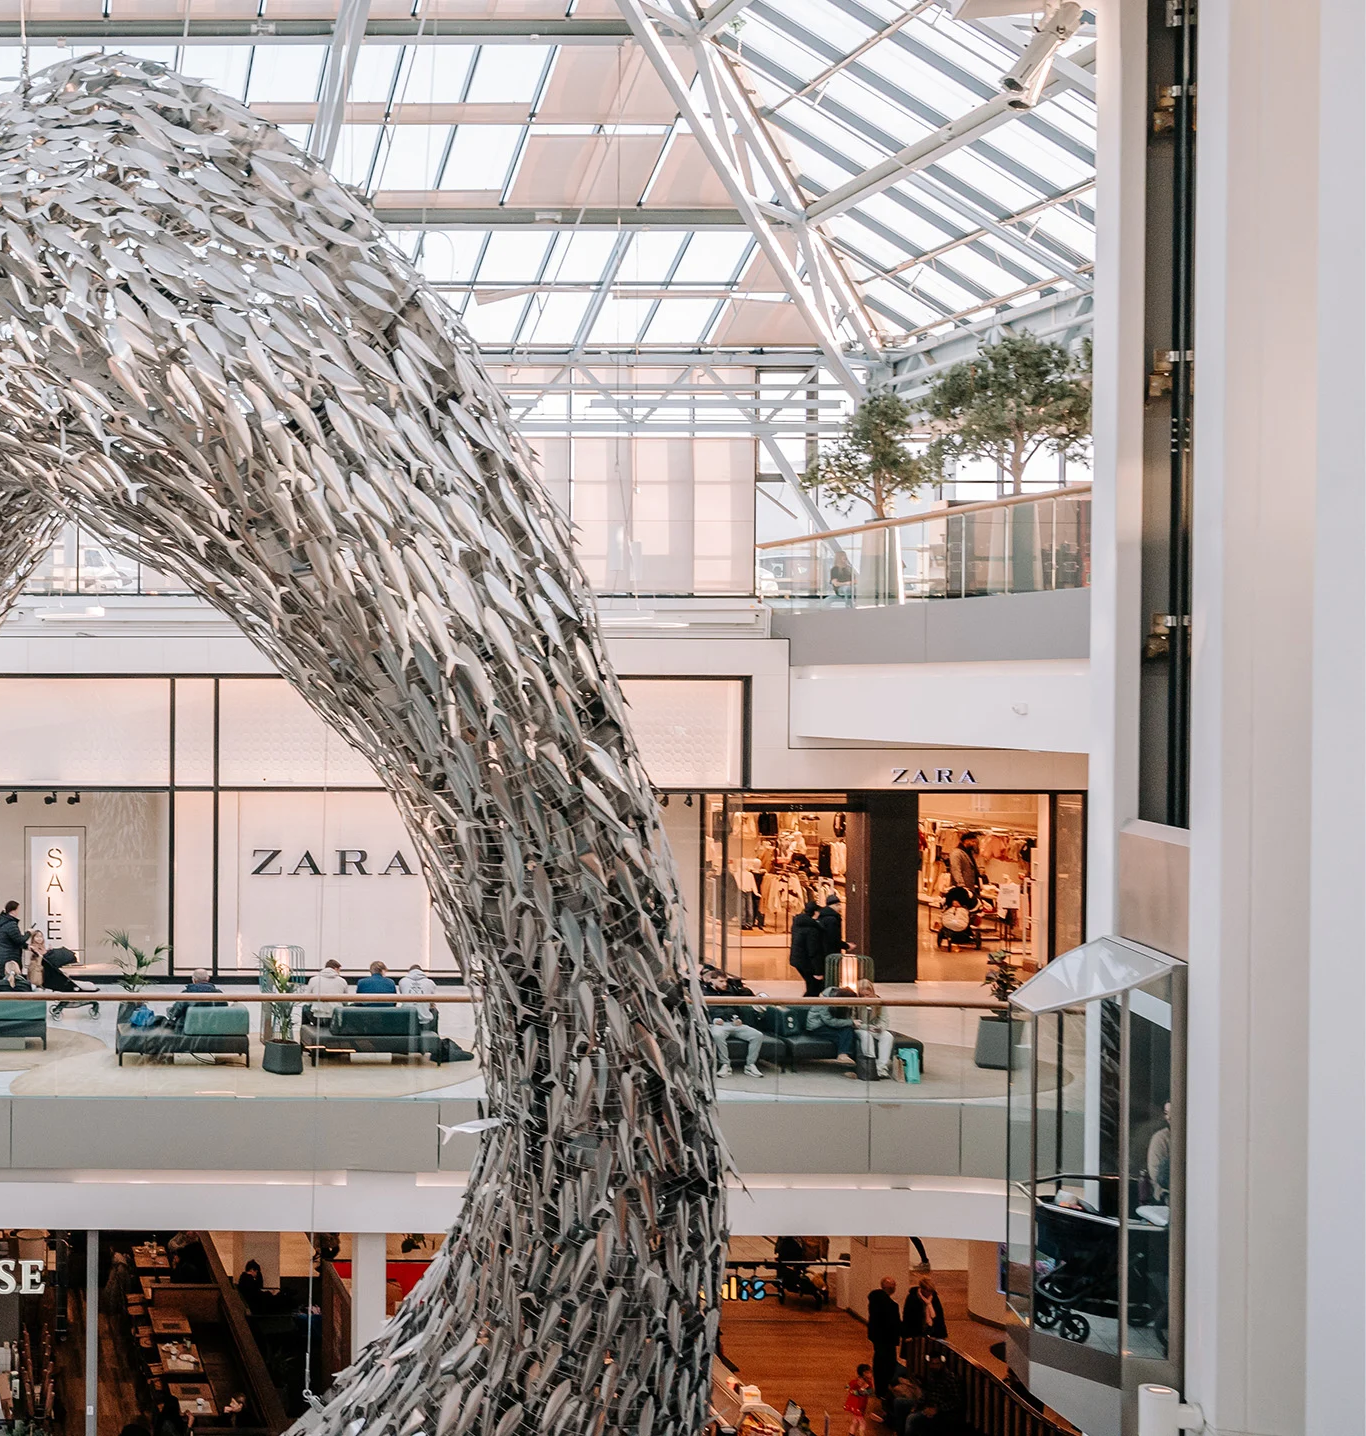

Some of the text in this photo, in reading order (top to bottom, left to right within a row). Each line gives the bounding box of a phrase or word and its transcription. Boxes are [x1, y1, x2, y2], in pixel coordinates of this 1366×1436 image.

[891, 767, 978, 784] ZARA
[251, 849, 418, 876] ZARA
[46, 847, 64, 940] SALE
